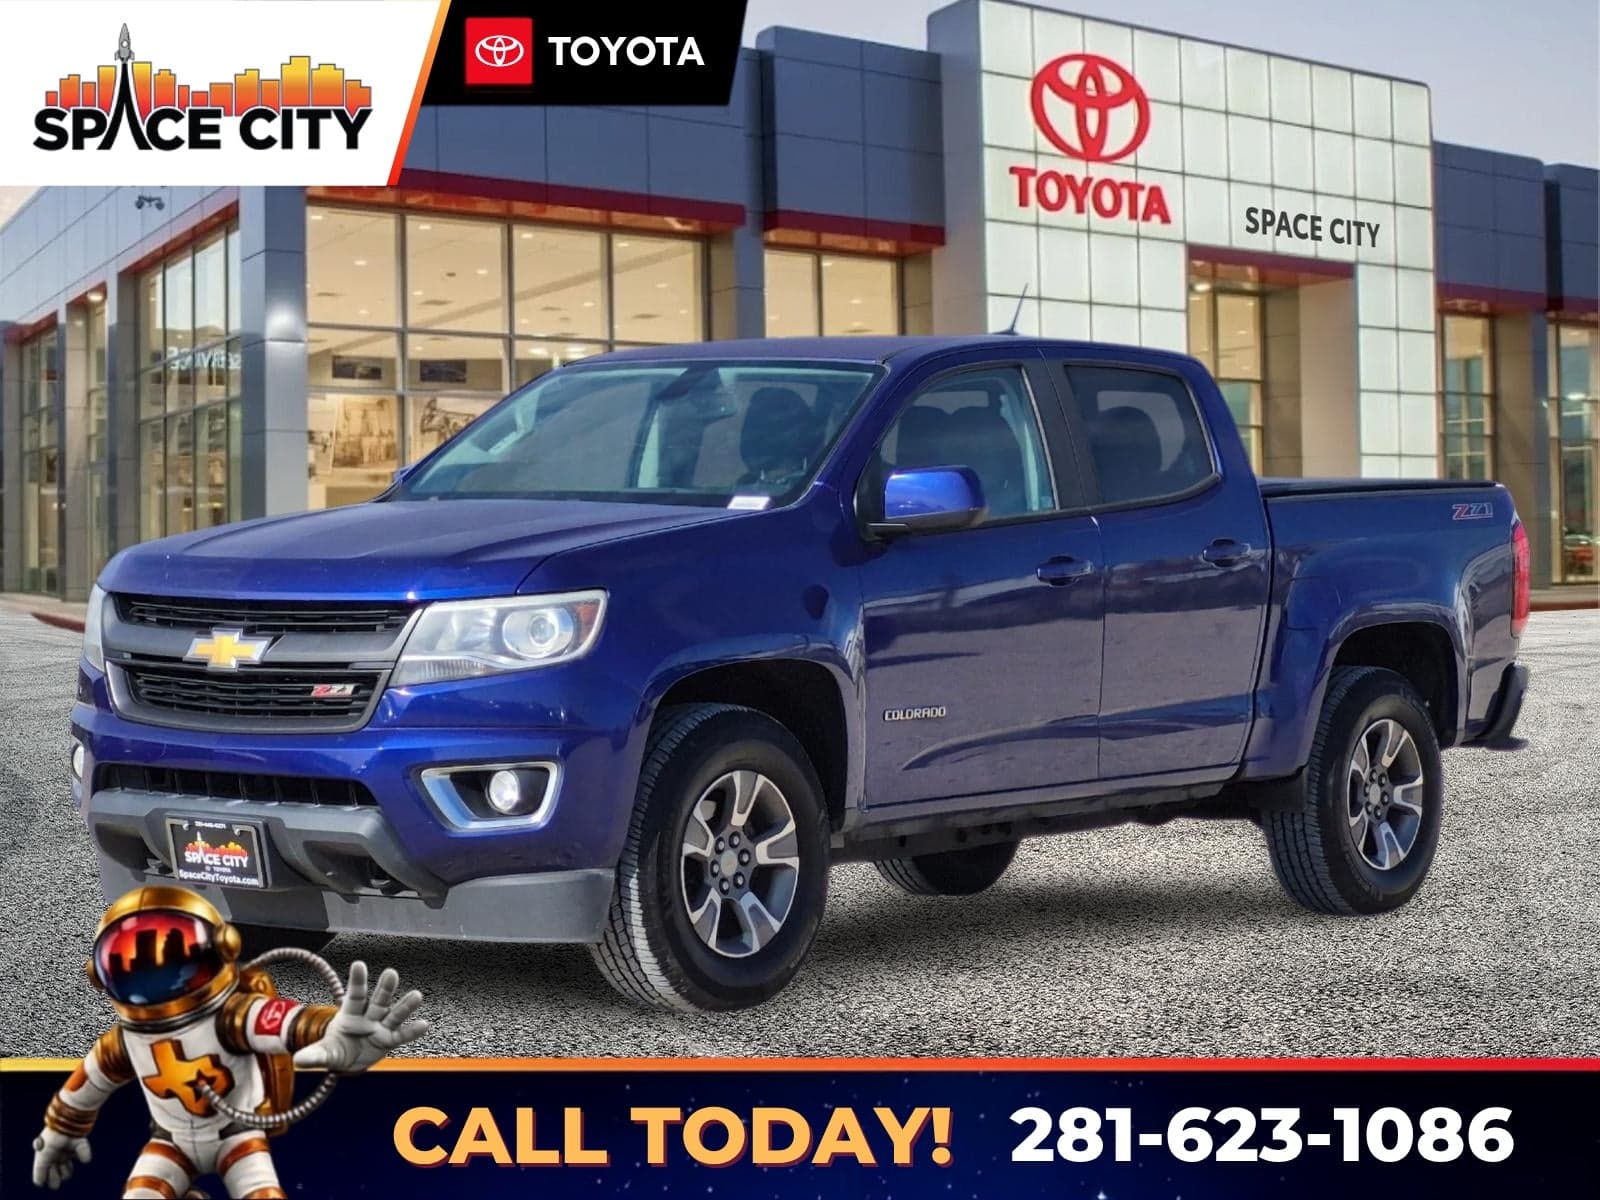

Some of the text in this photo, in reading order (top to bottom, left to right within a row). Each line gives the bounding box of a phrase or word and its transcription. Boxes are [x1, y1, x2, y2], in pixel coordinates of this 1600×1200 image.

[1009, 166, 1171, 225] TOYOTA
[1245, 206, 1381, 248] SPACE CITY
[1452, 502, 1494, 520] Z71
[883, 705, 947, 721] COLORADO
[184, 850, 249, 868] SPACE CITY
[179, 869, 259, 886] SpaceCityToyota.com
